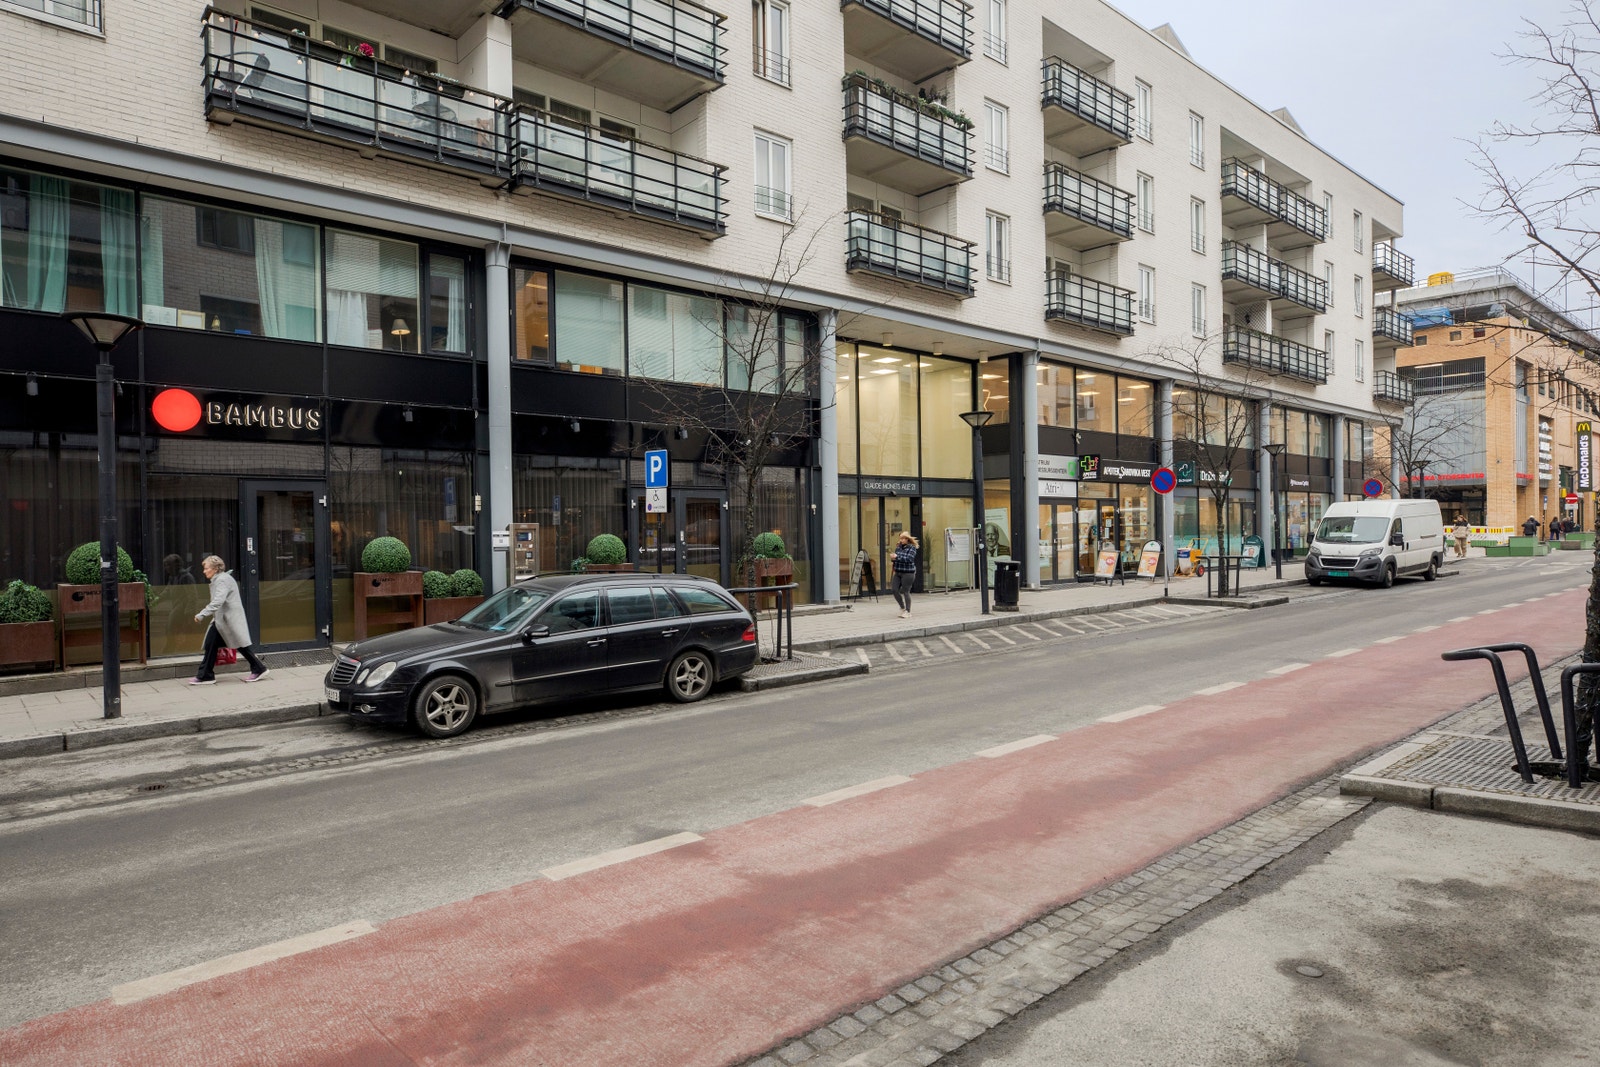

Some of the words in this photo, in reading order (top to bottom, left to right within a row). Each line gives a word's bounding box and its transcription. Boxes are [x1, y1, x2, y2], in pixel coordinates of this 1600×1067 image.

[206, 402, 322, 431] BAMBUS
[651, 455, 662, 483] P
[1104, 466, 1119, 476] APOTEK
[1141, 469, 1151, 478] VEST
[1579, 435, 1589, 488] McDonald's
[864, 482, 882, 490] CLAUDE
